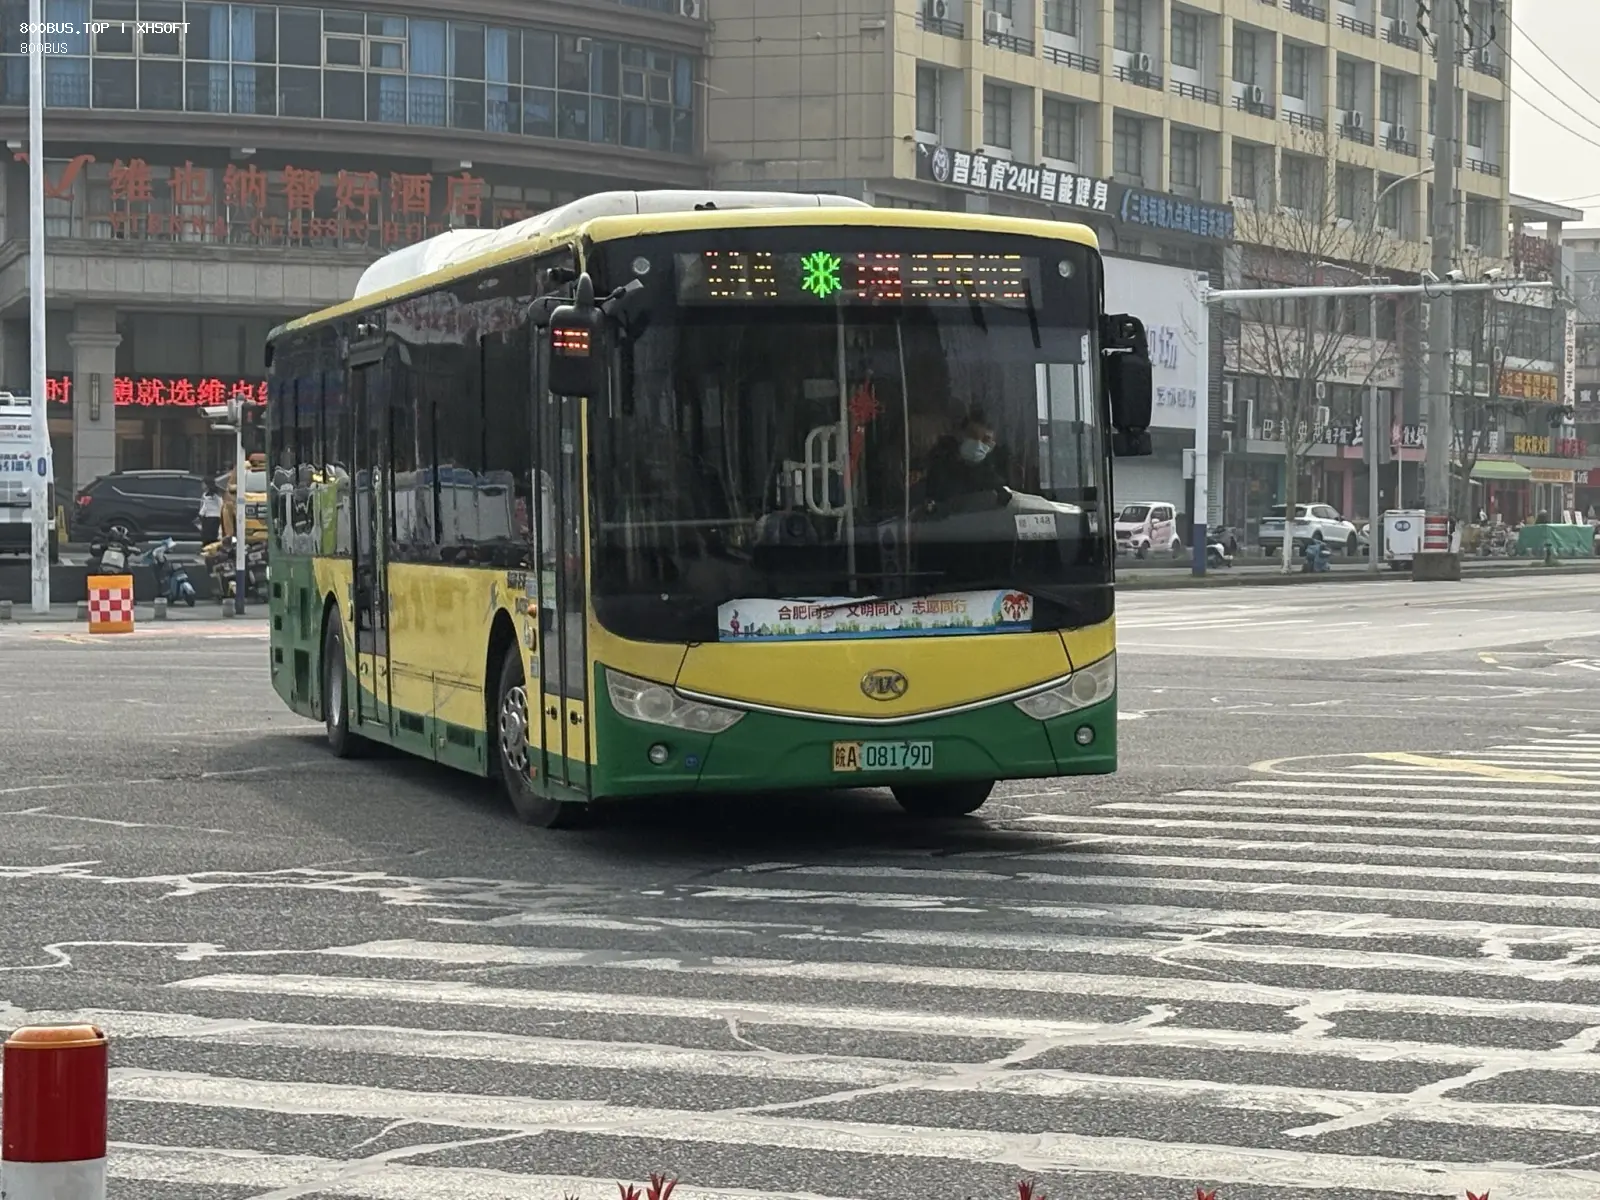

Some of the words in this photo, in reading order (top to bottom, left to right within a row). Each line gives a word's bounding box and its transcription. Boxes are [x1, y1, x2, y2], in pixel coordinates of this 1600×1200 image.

[109, 158, 486, 219] 维也纳智好酒店
[846, 601, 904, 618] 文明同心
[911, 600, 967, 615] 志愿同行
